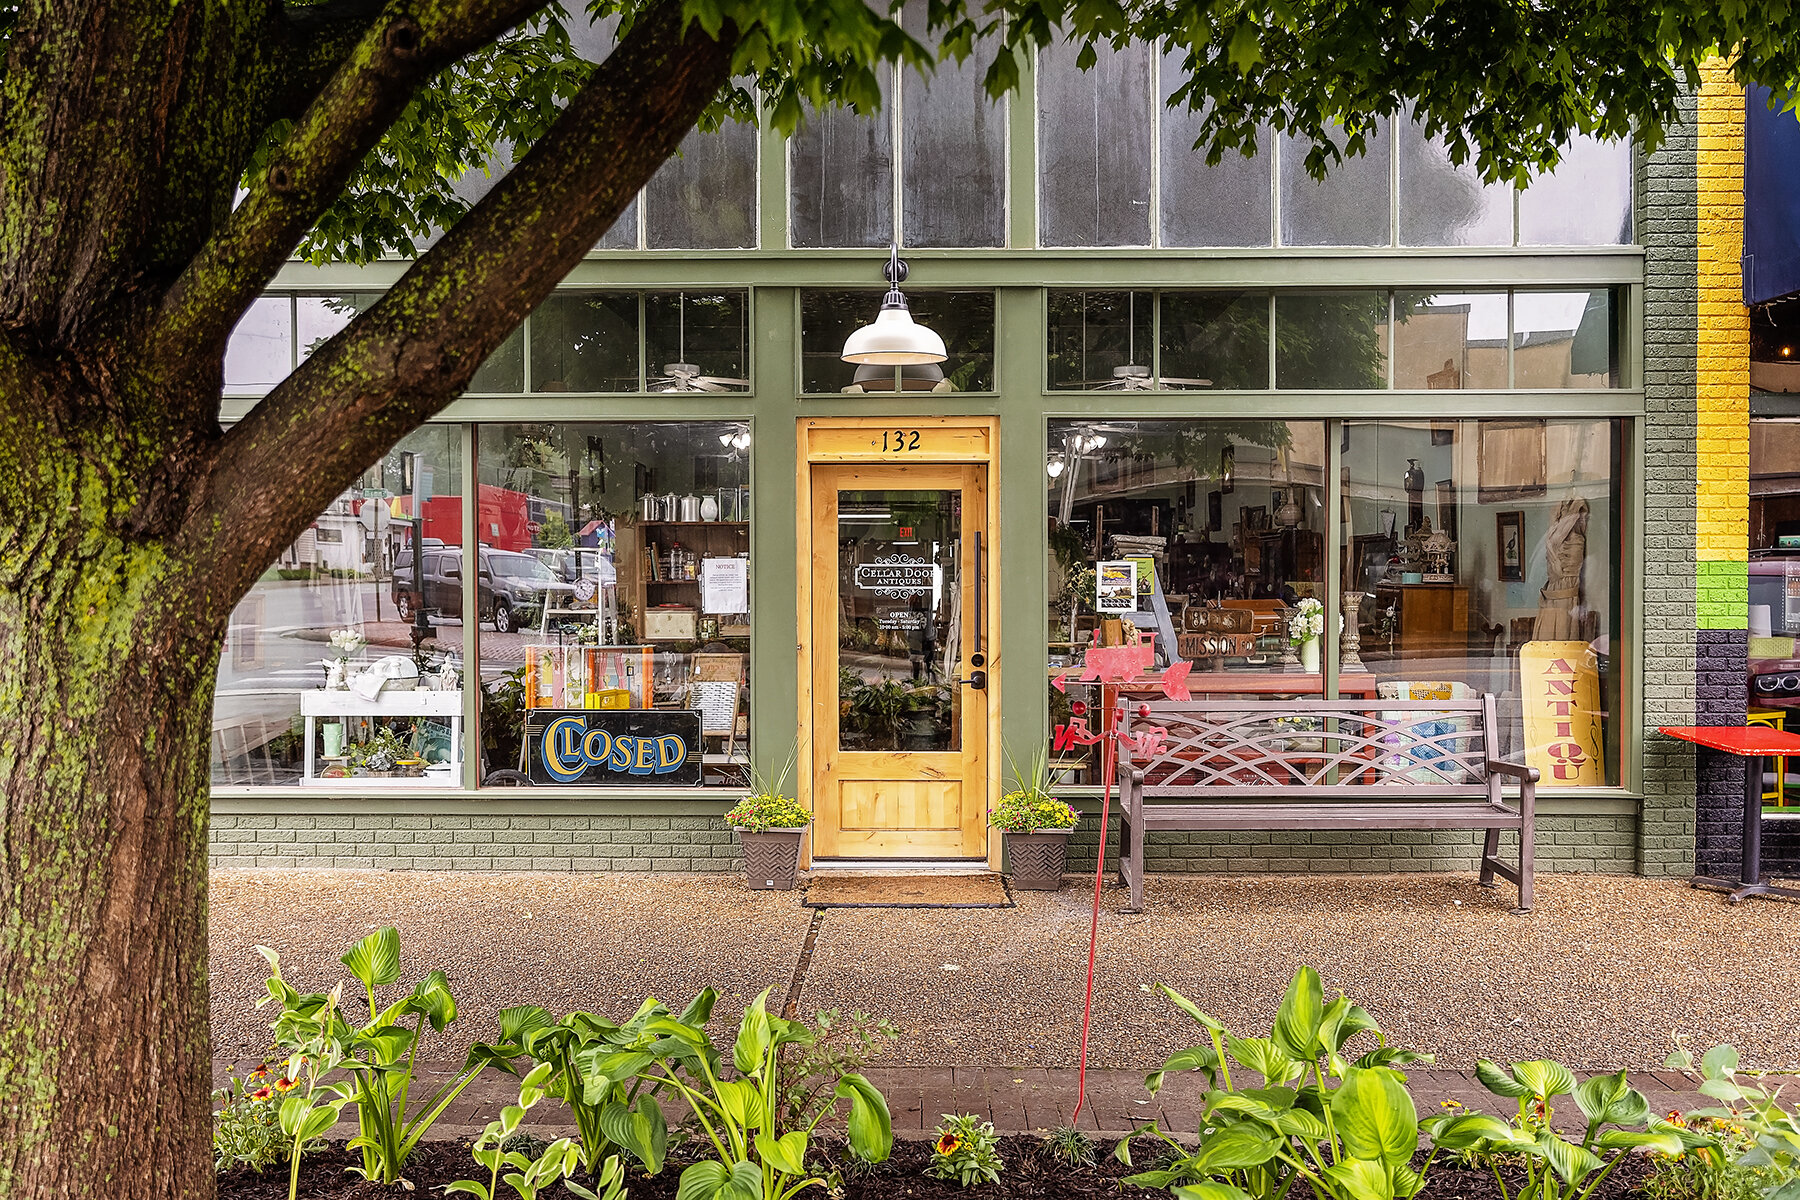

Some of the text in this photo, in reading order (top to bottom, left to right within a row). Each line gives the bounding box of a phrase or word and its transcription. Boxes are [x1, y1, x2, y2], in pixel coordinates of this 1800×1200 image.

[882, 430, 921, 453] 132
[899, 527, 913, 537] EXIT
[861, 567, 902, 578] CELLAR
[876, 578, 922, 587] ANTIQUES
[889, 611, 909, 619] OPEN
[1185, 636, 1237, 655] MISSION
[1541, 658, 1587, 786] ANTIQU
[541, 715, 687, 783] CLOSED
